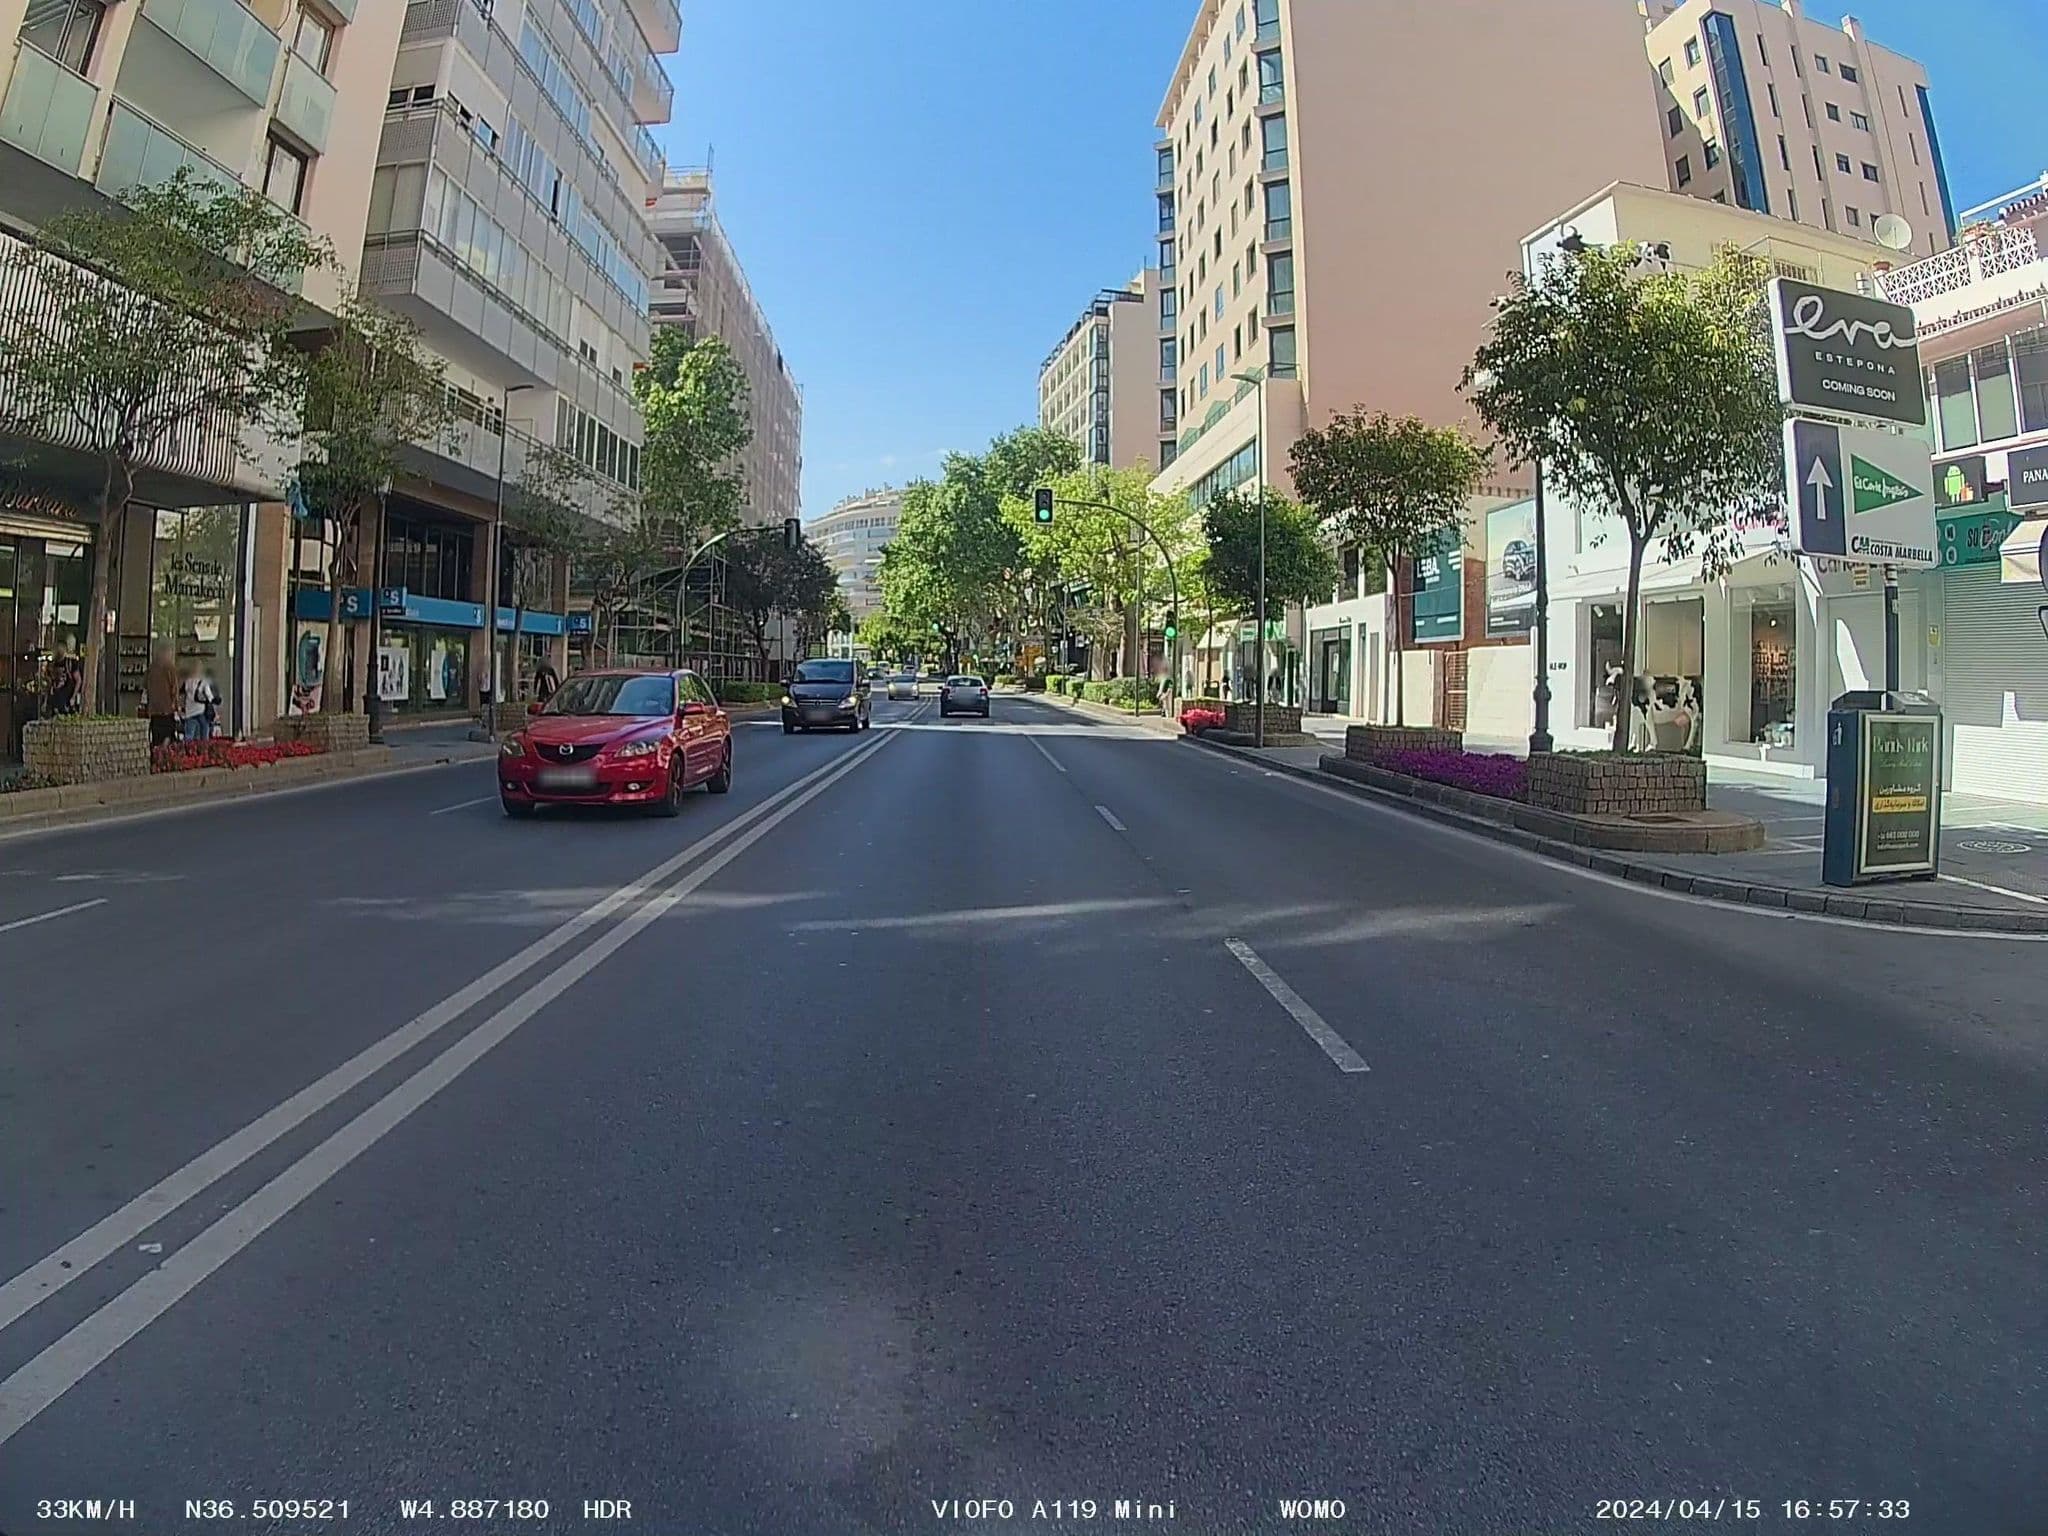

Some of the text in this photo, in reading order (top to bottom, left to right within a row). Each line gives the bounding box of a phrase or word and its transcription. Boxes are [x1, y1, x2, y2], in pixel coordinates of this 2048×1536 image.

[1784, 295, 1918, 349] eva
[1815, 351, 1896, 375] ESTEPONA
[1822, 379, 1896, 402] COMING SOON
[1870, 544, 1933, 562] COSTA MARBELLA
[165, 574, 225, 600] Marrakech
